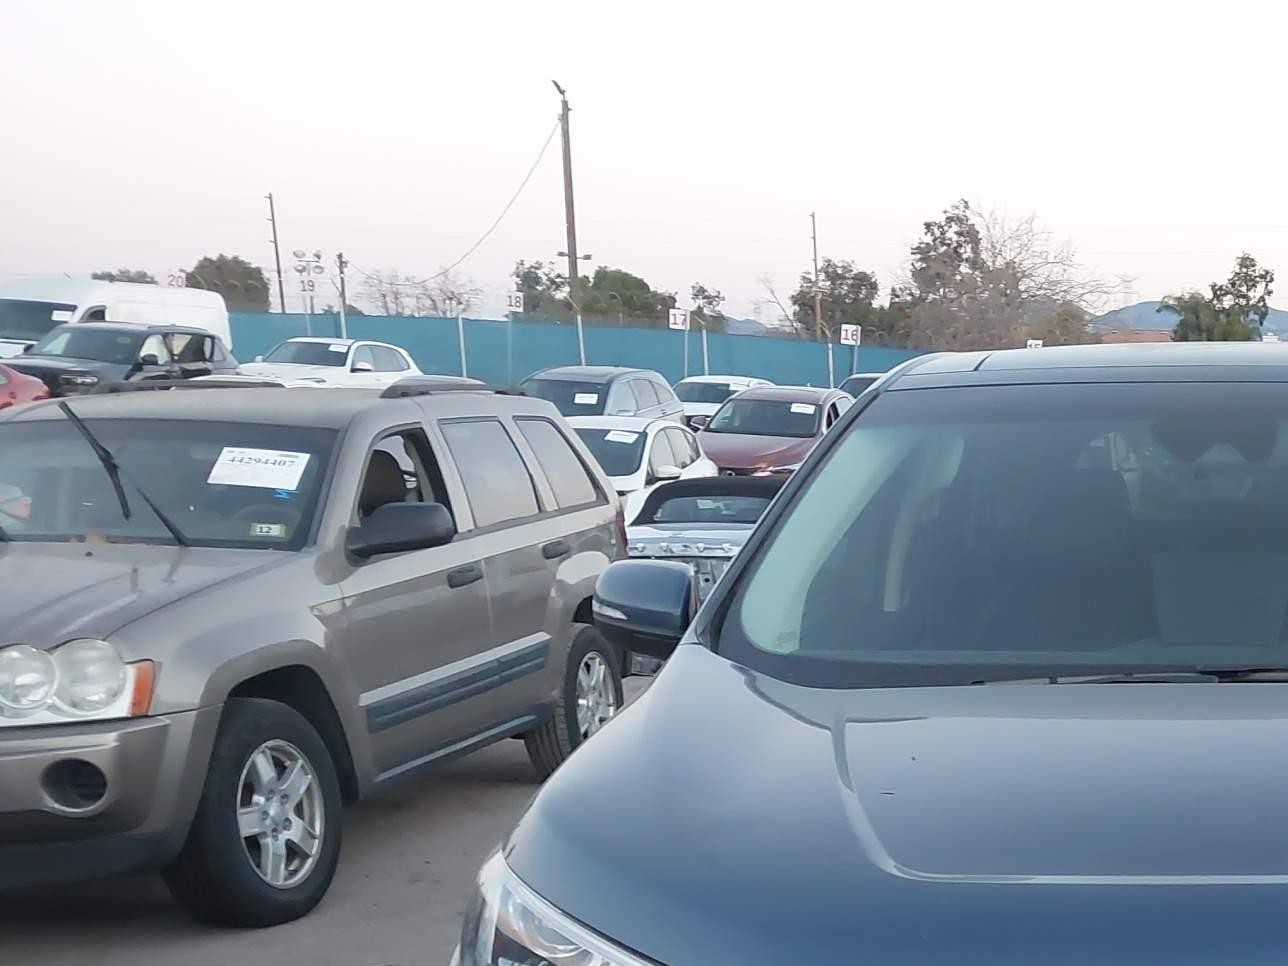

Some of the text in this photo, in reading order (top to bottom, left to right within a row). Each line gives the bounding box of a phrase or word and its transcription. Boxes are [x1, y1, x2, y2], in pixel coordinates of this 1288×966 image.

[168, 274, 185, 287] 20
[301, 280, 315, 292] 19
[507, 295, 522, 308] 18
[671, 313, 688, 326] 17
[841, 328, 858, 341] 16
